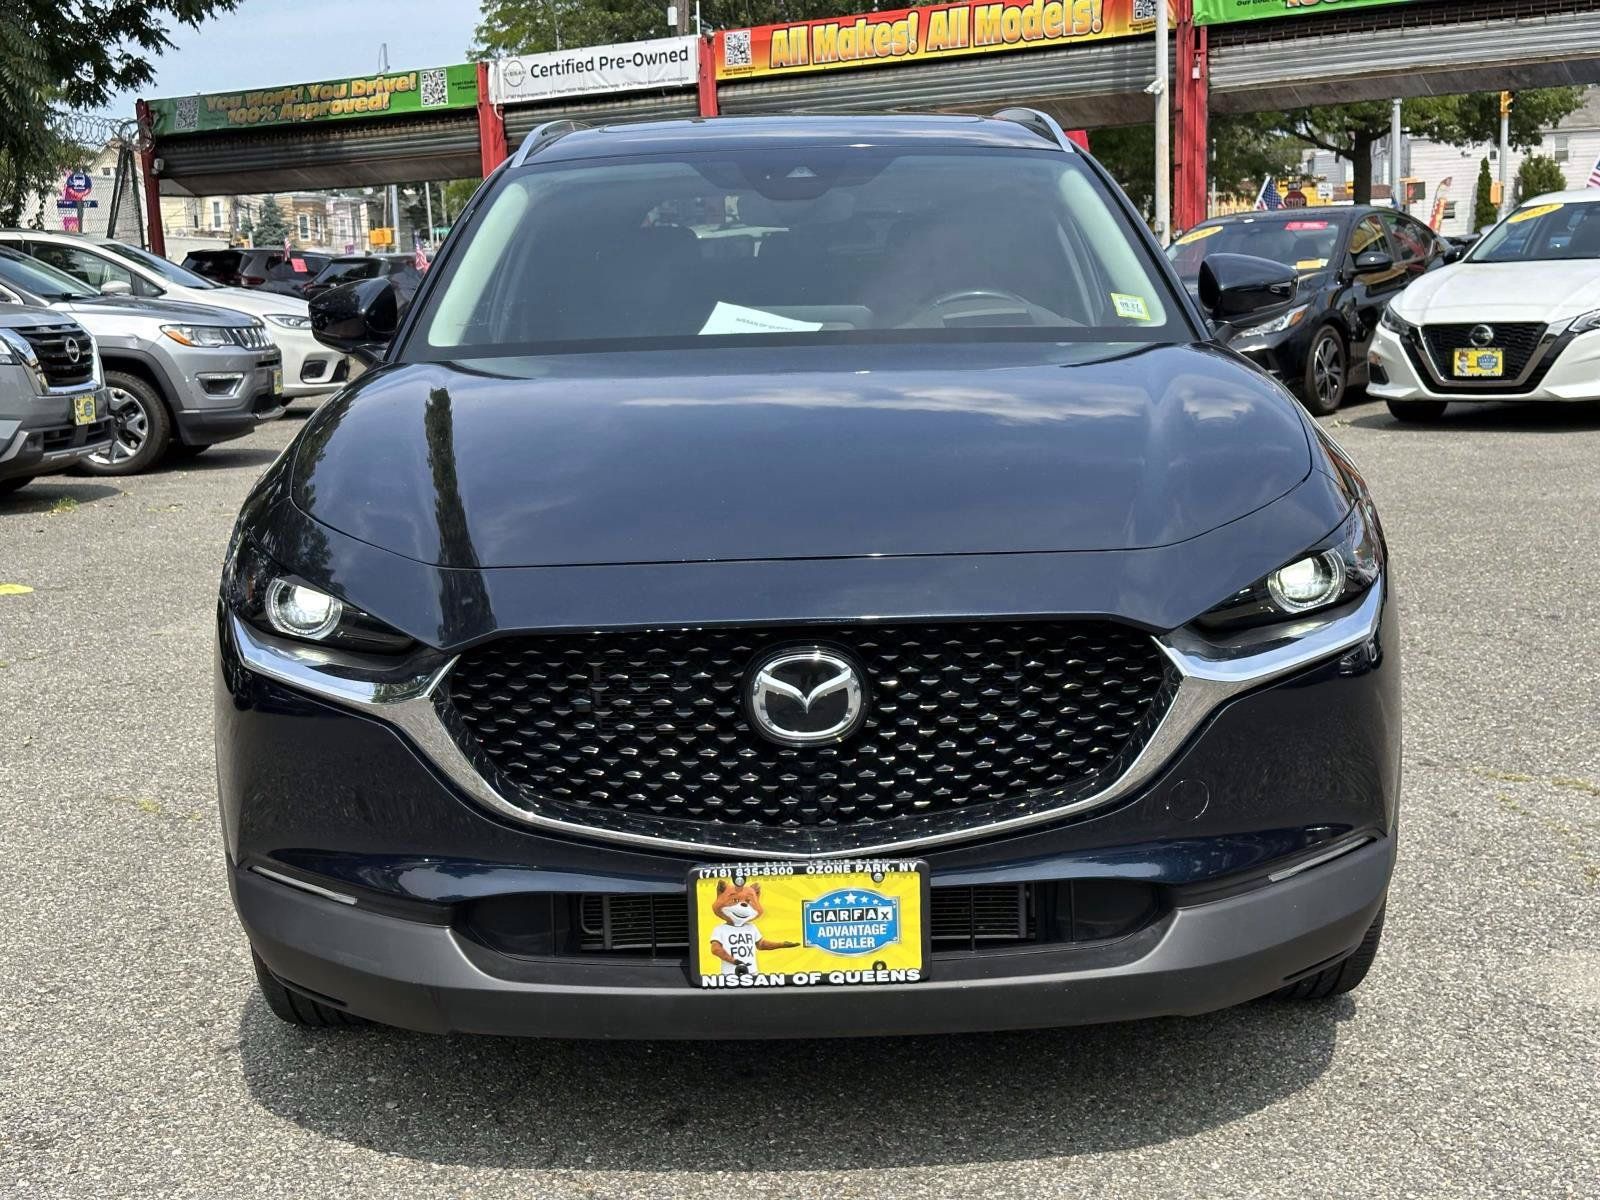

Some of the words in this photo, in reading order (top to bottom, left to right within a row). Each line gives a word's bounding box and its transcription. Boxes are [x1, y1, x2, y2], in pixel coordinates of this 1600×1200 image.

[770, 25, 809, 68] All
[812, 11, 919, 64] Makes!
[925, 5, 970, 52] All
[974, 0, 1103, 46] Models!
[530, 55, 595, 78] Certified
[599, 46, 689, 71] Pre-Owned
[205, 94, 242, 112] You
[245, 84, 304, 109] Work!
[307, 82, 348, 101] You
[350, 72, 417, 98] Drive!
[227, 104, 276, 125] 100%
[279, 92, 390, 123] Approved!
[1285, 198, 1306, 208] STOP
[699, 869, 732, 879] (718)
[806, 864, 851, 875] OZONE
[855, 863, 895, 873] PARK,
[899, 862, 917, 872] NY
[817, 923, 887, 938] ADVANTAGE
[728, 933, 754, 945] CAR
[830, 936, 876, 949] DEALER
[730, 946, 754, 958] FOX
[701, 973, 785, 988] NISSAN
[792, 971, 822, 985] OF
[828, 969, 921, 985] QUEENS
